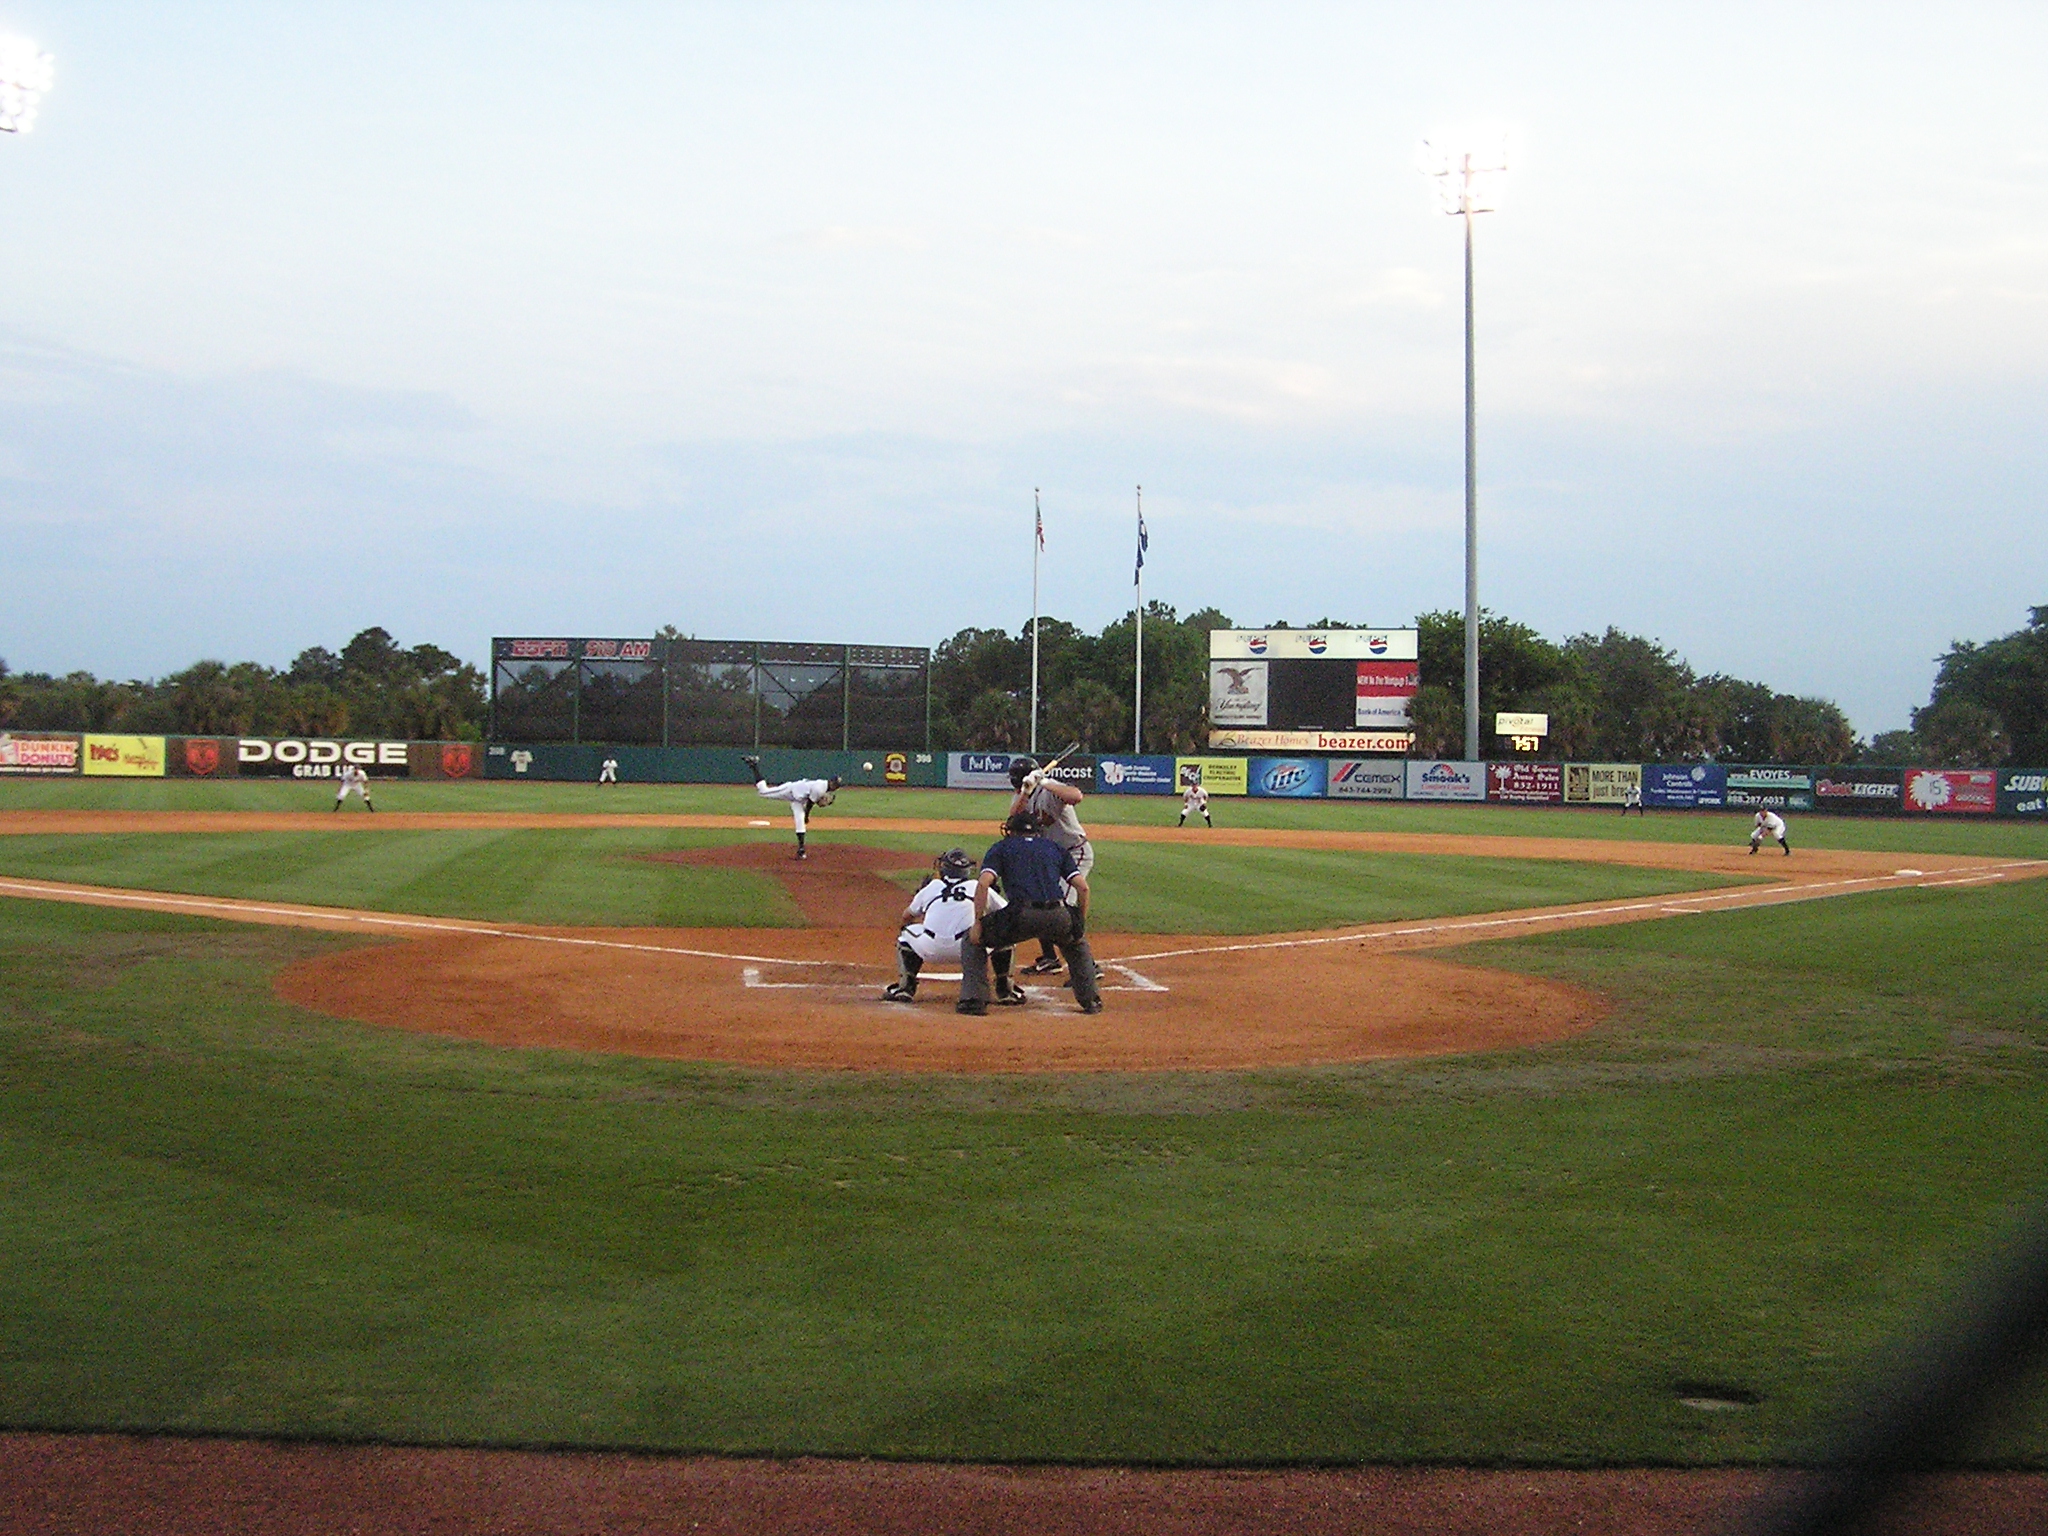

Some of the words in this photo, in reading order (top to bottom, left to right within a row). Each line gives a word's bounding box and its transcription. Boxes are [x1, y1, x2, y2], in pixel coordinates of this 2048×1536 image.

[512, 640, 568, 657] ESPN
[620, 641, 652, 657] AM
[1237, 734, 1272, 745] Beazer
[1275, 735, 1309, 745] Homes
[1318, 734, 1410, 750] beazer.com
[21, 753, 74, 763] DONUTS
[238, 739, 408, 764] DODGE
[293, 764, 331, 777] GRAB
[1044, 766, 1092, 779] omcast
[1592, 770, 1614, 782] MORE
[1617, 770, 1638, 782] THAN
[1355, 774, 1401, 783] CEMEX
[1422, 773, 1470, 783] Smoak's
[1593, 785, 1608, 799] just
[1853, 783, 1900, 797] LIGHT
[2016, 798, 2042, 812] eat
